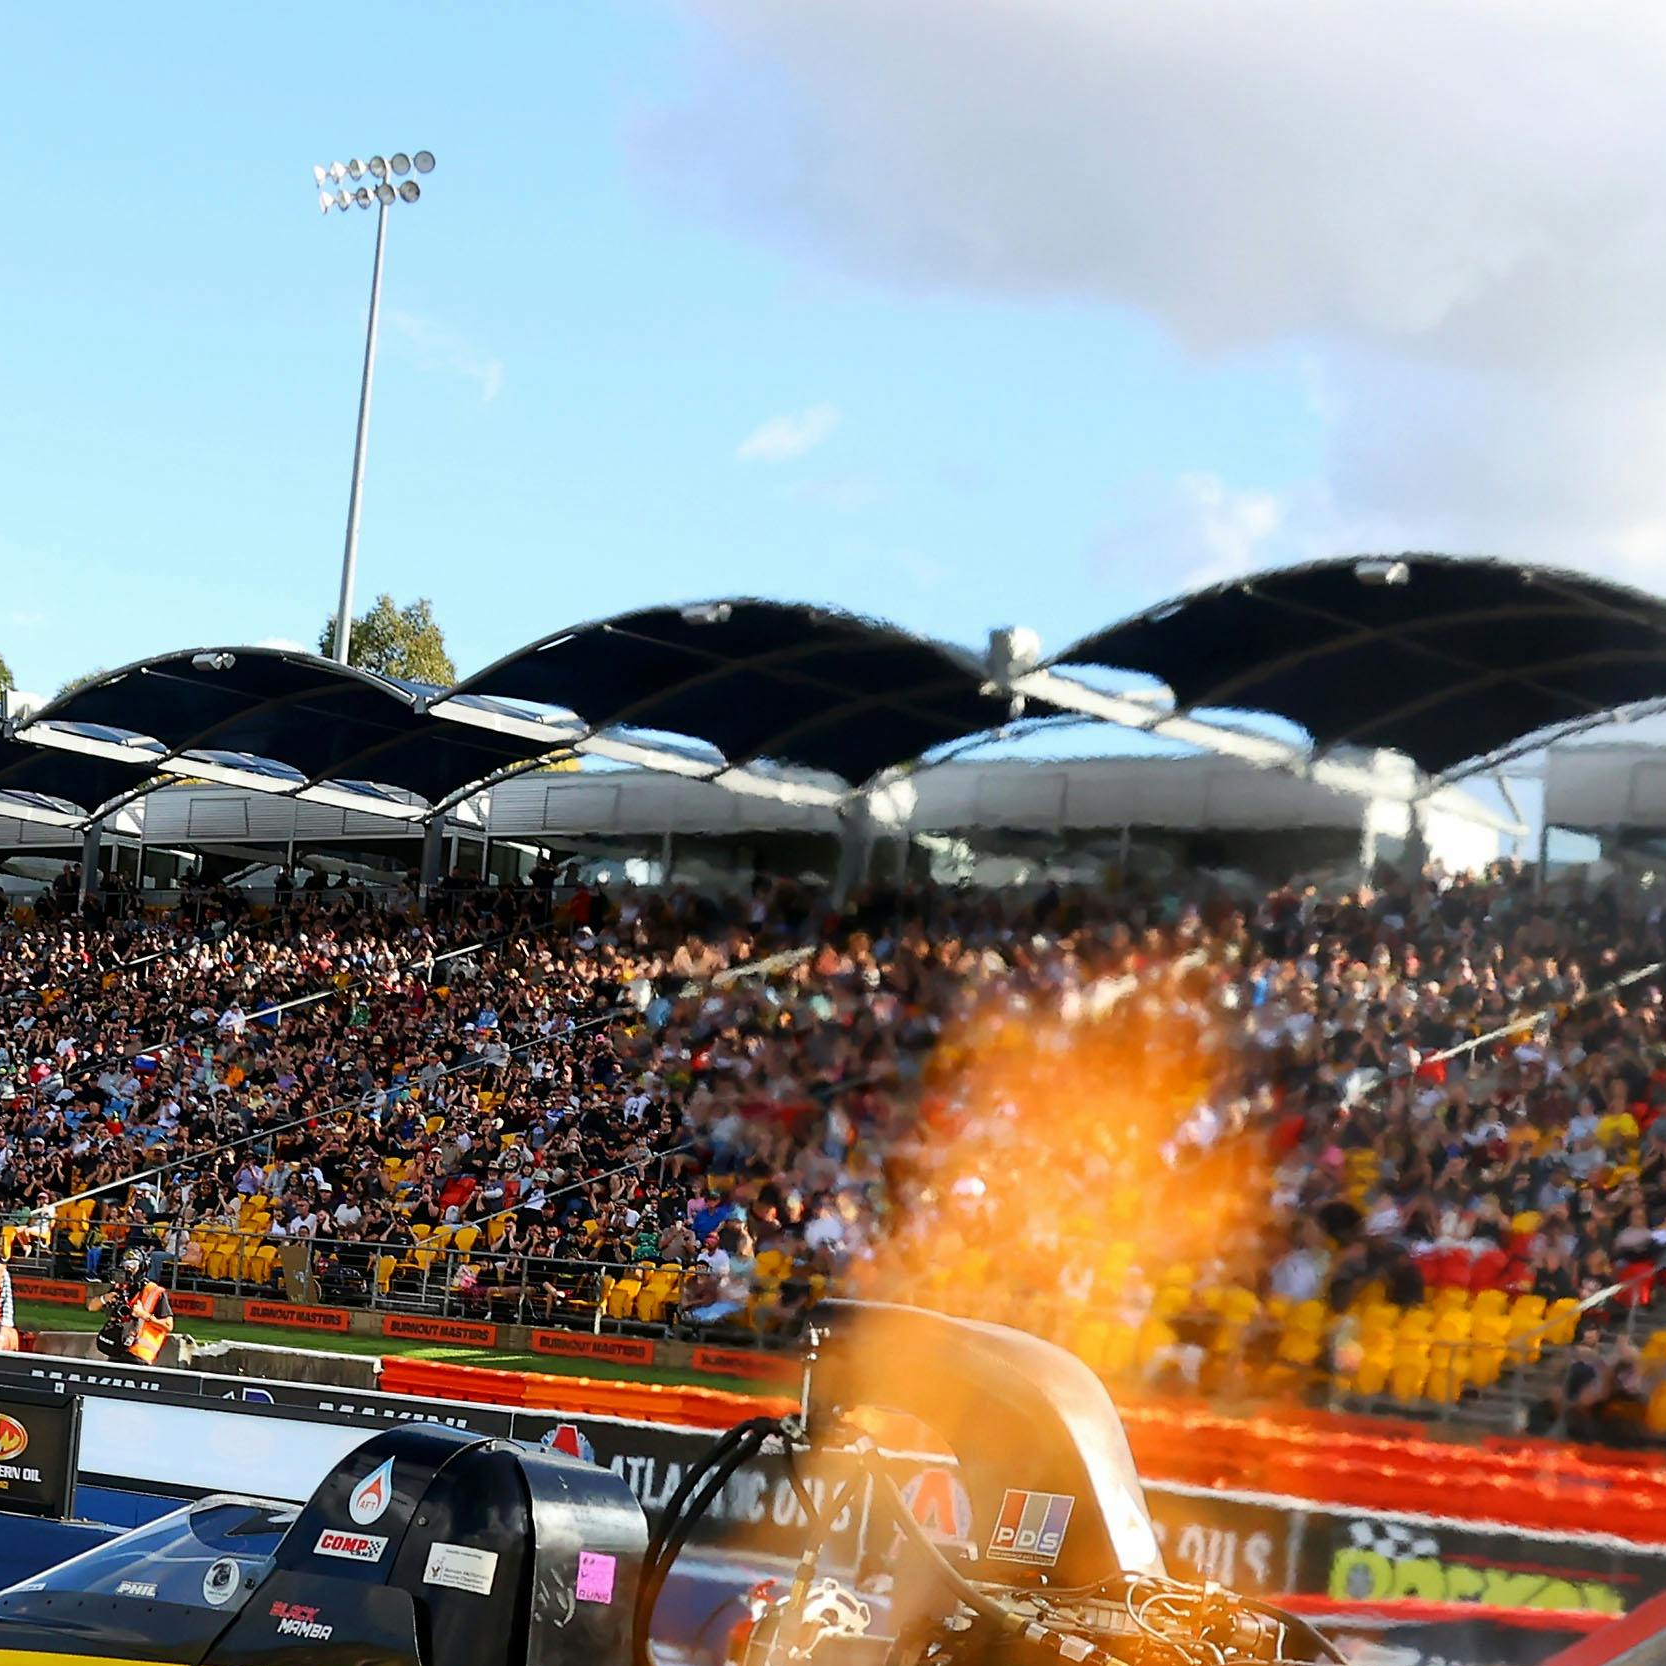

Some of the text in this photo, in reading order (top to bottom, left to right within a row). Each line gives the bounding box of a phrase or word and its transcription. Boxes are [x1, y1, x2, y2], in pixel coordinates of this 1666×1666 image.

[250, 1305, 342, 1326] BURNOUT MASTERS
[390, 1319, 489, 1341] BURNOUT MASTERS
[22, 1467, 42, 1483] OIL
[320, 1534, 369, 1553] COMP
[996, 1526, 1060, 1550] PDS
[116, 1578, 158, 1600] PHIL
[269, 1600, 321, 1623] BLACK
[276, 1617, 334, 1641] MAMBA
